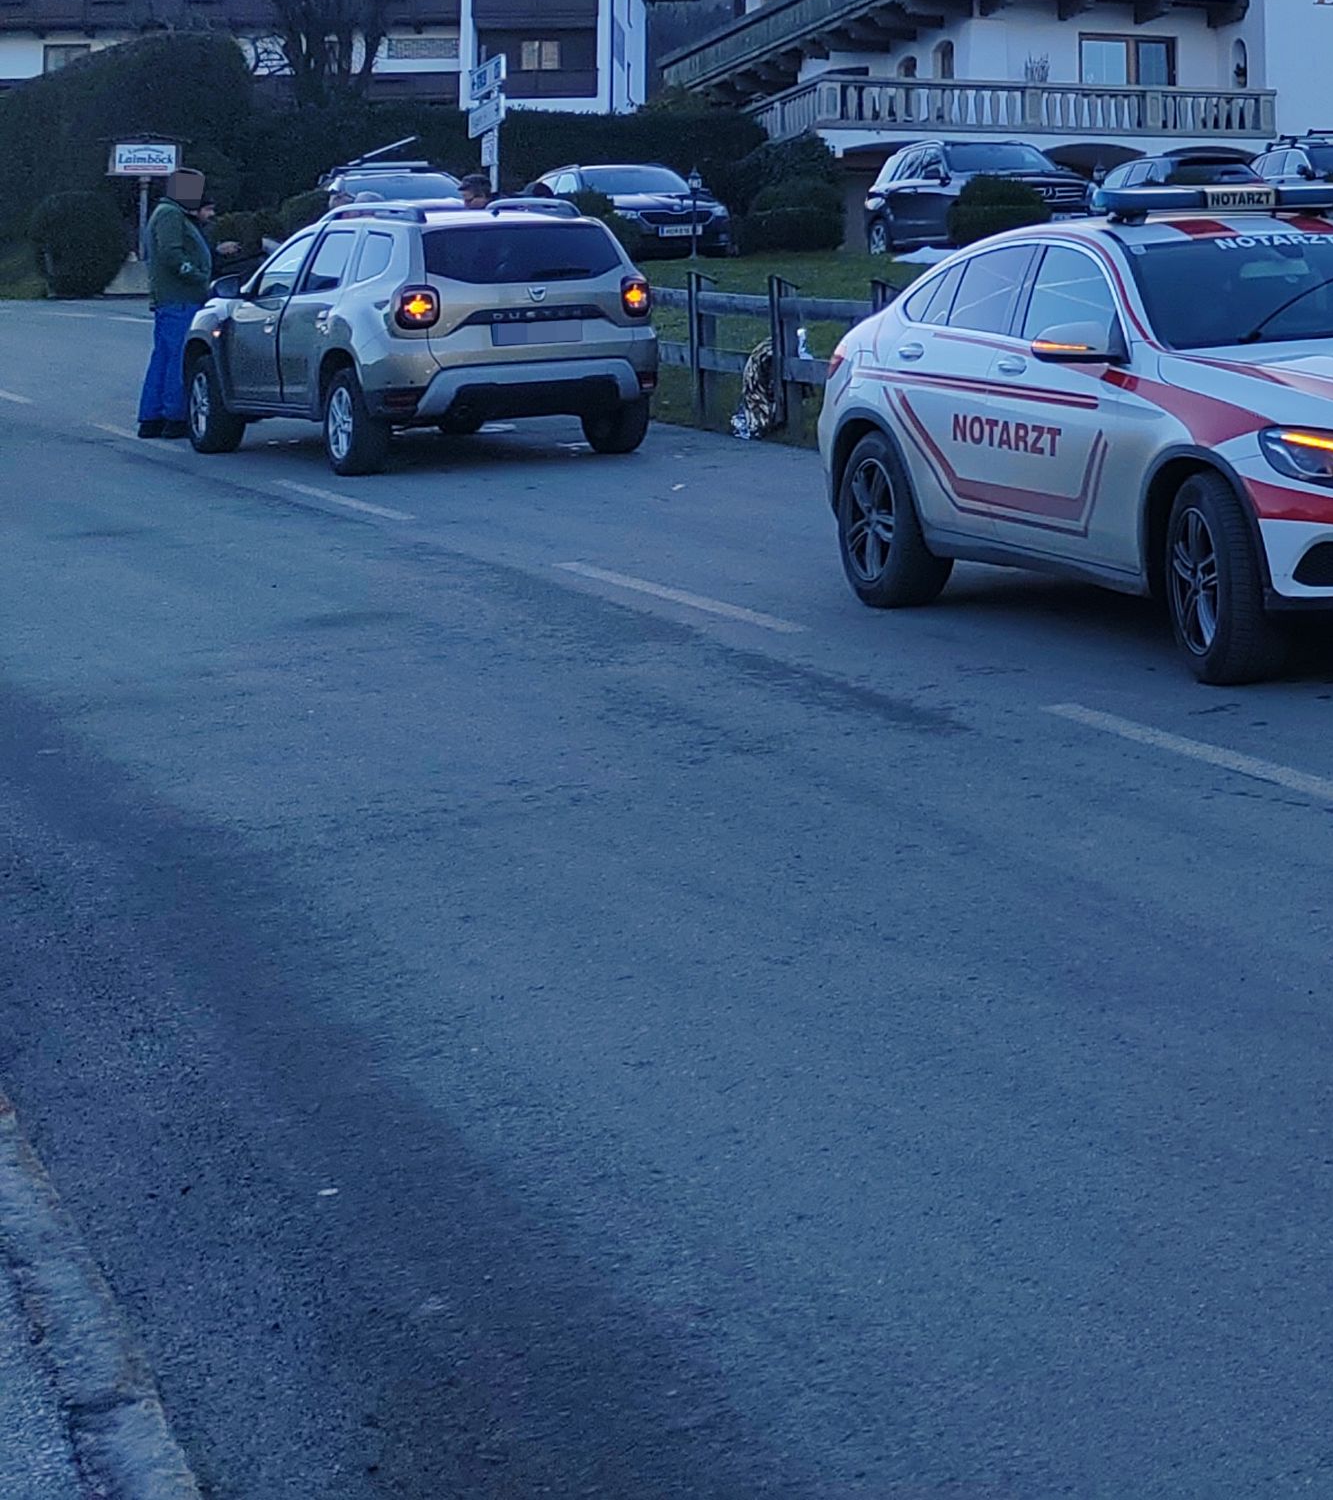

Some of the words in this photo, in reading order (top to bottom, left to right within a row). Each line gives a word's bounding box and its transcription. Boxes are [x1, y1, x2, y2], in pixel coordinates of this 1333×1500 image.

[118, 153, 174, 165] Laimböck
[1211, 191, 1271, 206] NOTARZT
[952, 413, 1062, 457] NOTARZT
